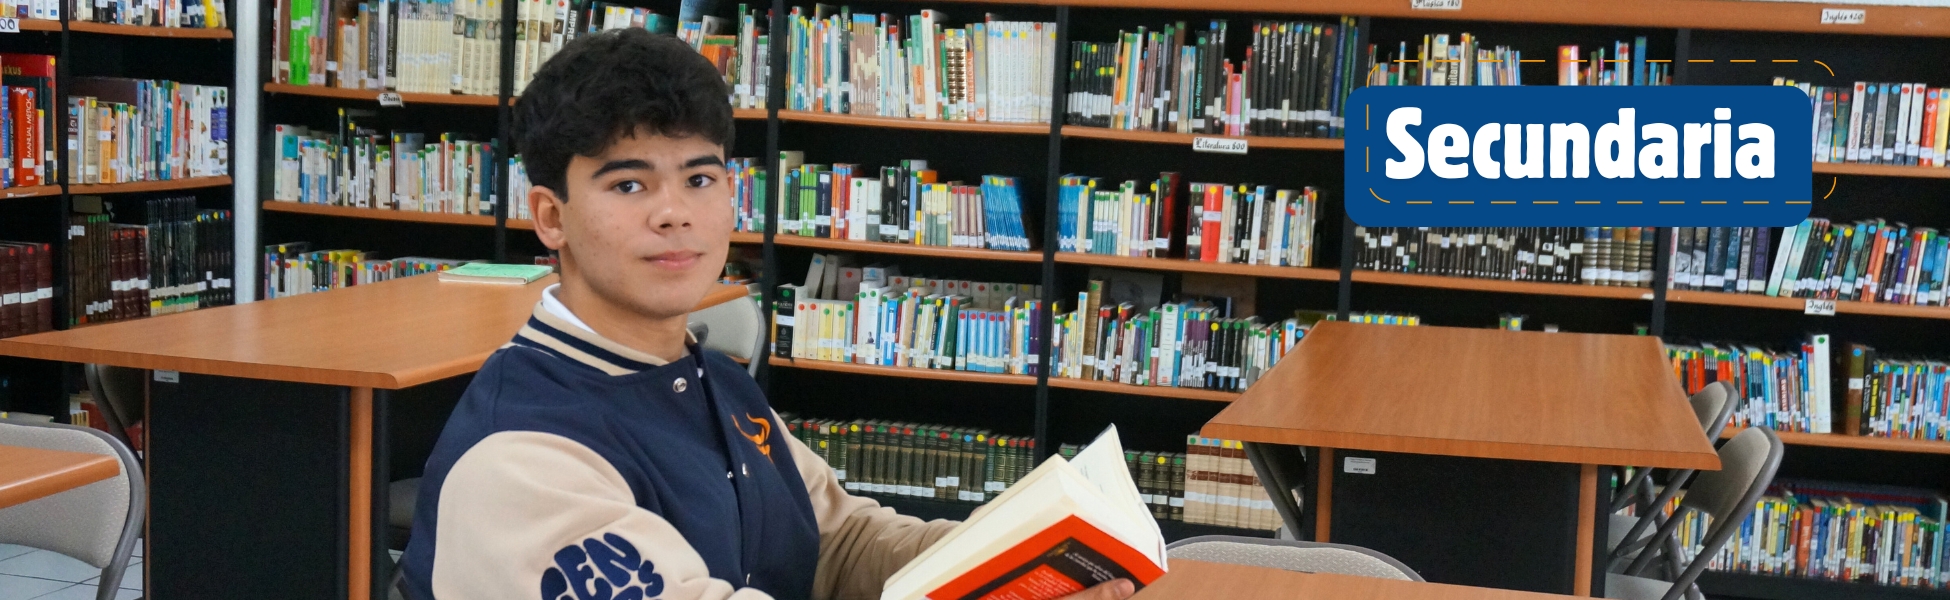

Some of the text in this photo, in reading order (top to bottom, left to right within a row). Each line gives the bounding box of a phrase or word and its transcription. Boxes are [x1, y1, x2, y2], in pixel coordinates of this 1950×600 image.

[566, 10, 577, 41] IMPRE
[1195, 137, 1230, 150] Literatura
[1808, 300, 1834, 313] Inglés
